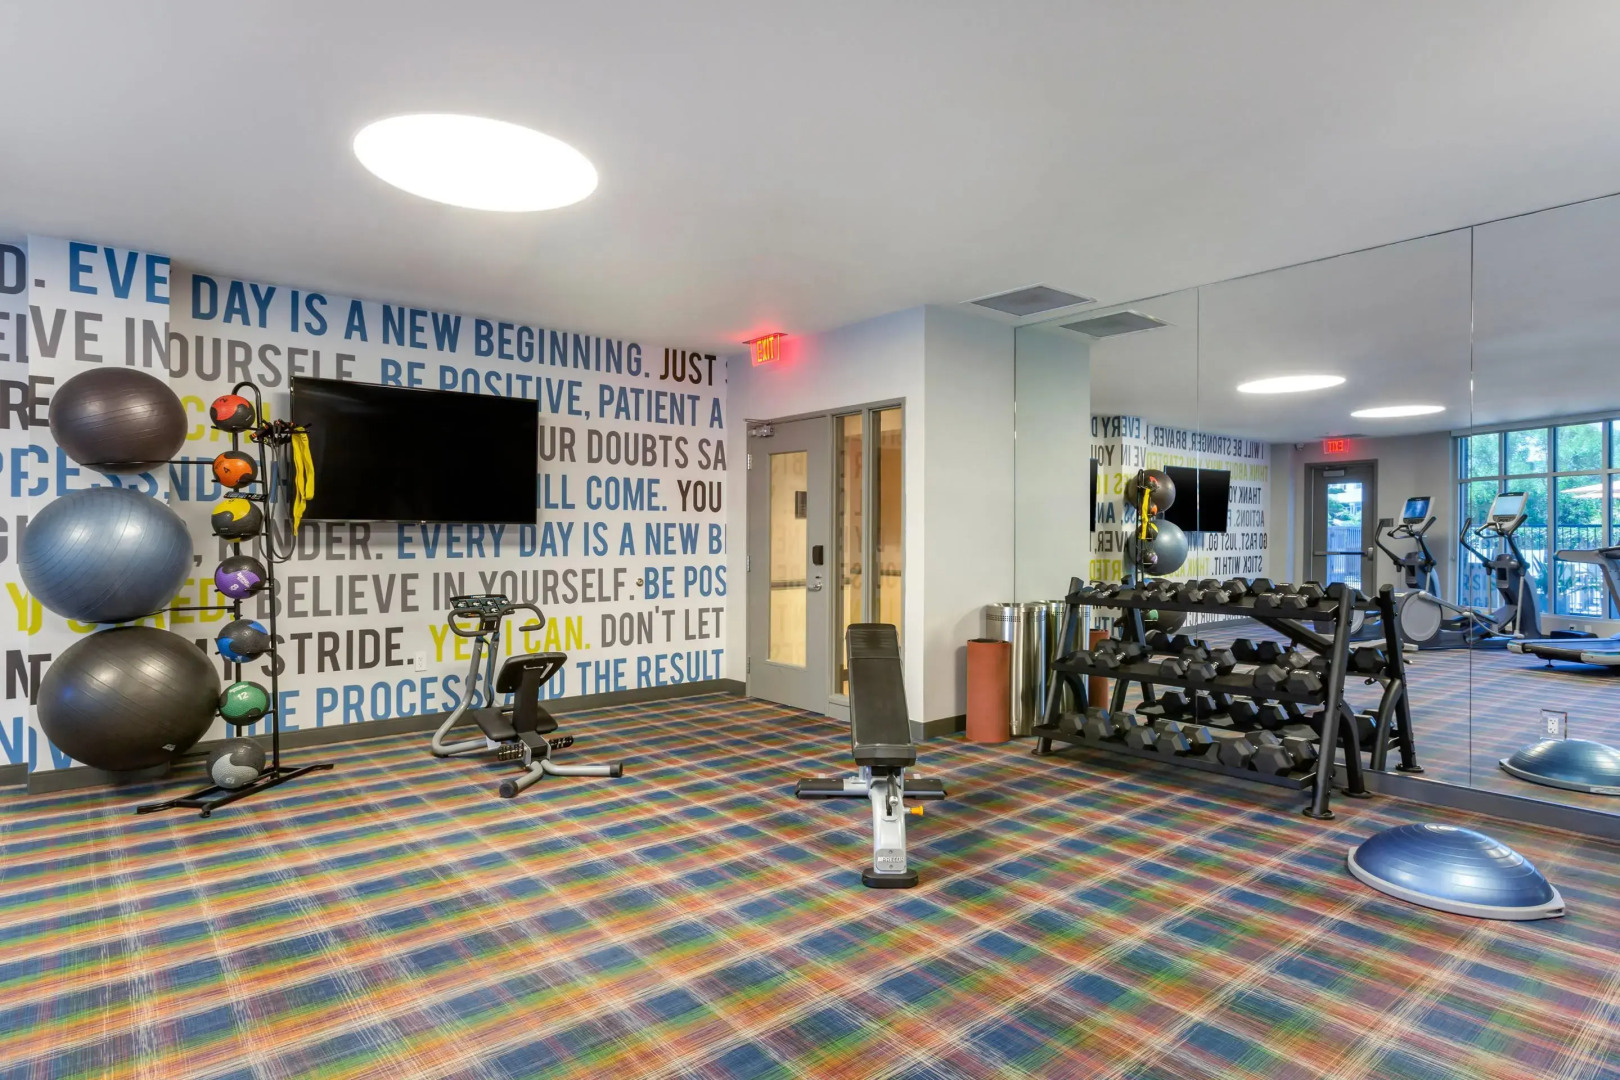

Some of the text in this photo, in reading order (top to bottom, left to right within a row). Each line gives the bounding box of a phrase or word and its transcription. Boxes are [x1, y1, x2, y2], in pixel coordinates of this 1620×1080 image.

[191, 273, 276, 329] DAY
[290, 290, 328, 336] IS
[344, 300, 368, 342] A
[382, 305, 461, 353] NEW
[474, 319, 649, 378] BEGINNING.
[659, 348, 716, 386] JUST
[756, 336, 774, 363] EXIT
[599, 384, 700, 427] PATIENT
[588, 428, 688, 469] DOUBTS
[587, 475, 667, 511] COME.
[677, 479, 722, 513] YOU
[398, 523, 506, 559] EVERY
[519, 522, 574, 557] DAY
[584, 521, 608, 556] IS
[619, 523, 636, 555] A
[645, 523, 699, 555] NEW
[257, 573, 419, 620] BELIEVE
[433, 572, 464, 610] IN
[478, 568, 634, 606] YOURSELF.
[645, 566, 675, 599] BE
[261, 627, 414, 677] STRIDE.
[524, 615, 591, 655] CAN.
[601, 606, 675, 648] DON'T
[685, 607, 724, 640] LET
[577, 658, 627, 696] THE
[637, 649, 724, 689] RESULT
[237, 691, 250, 701] 12
